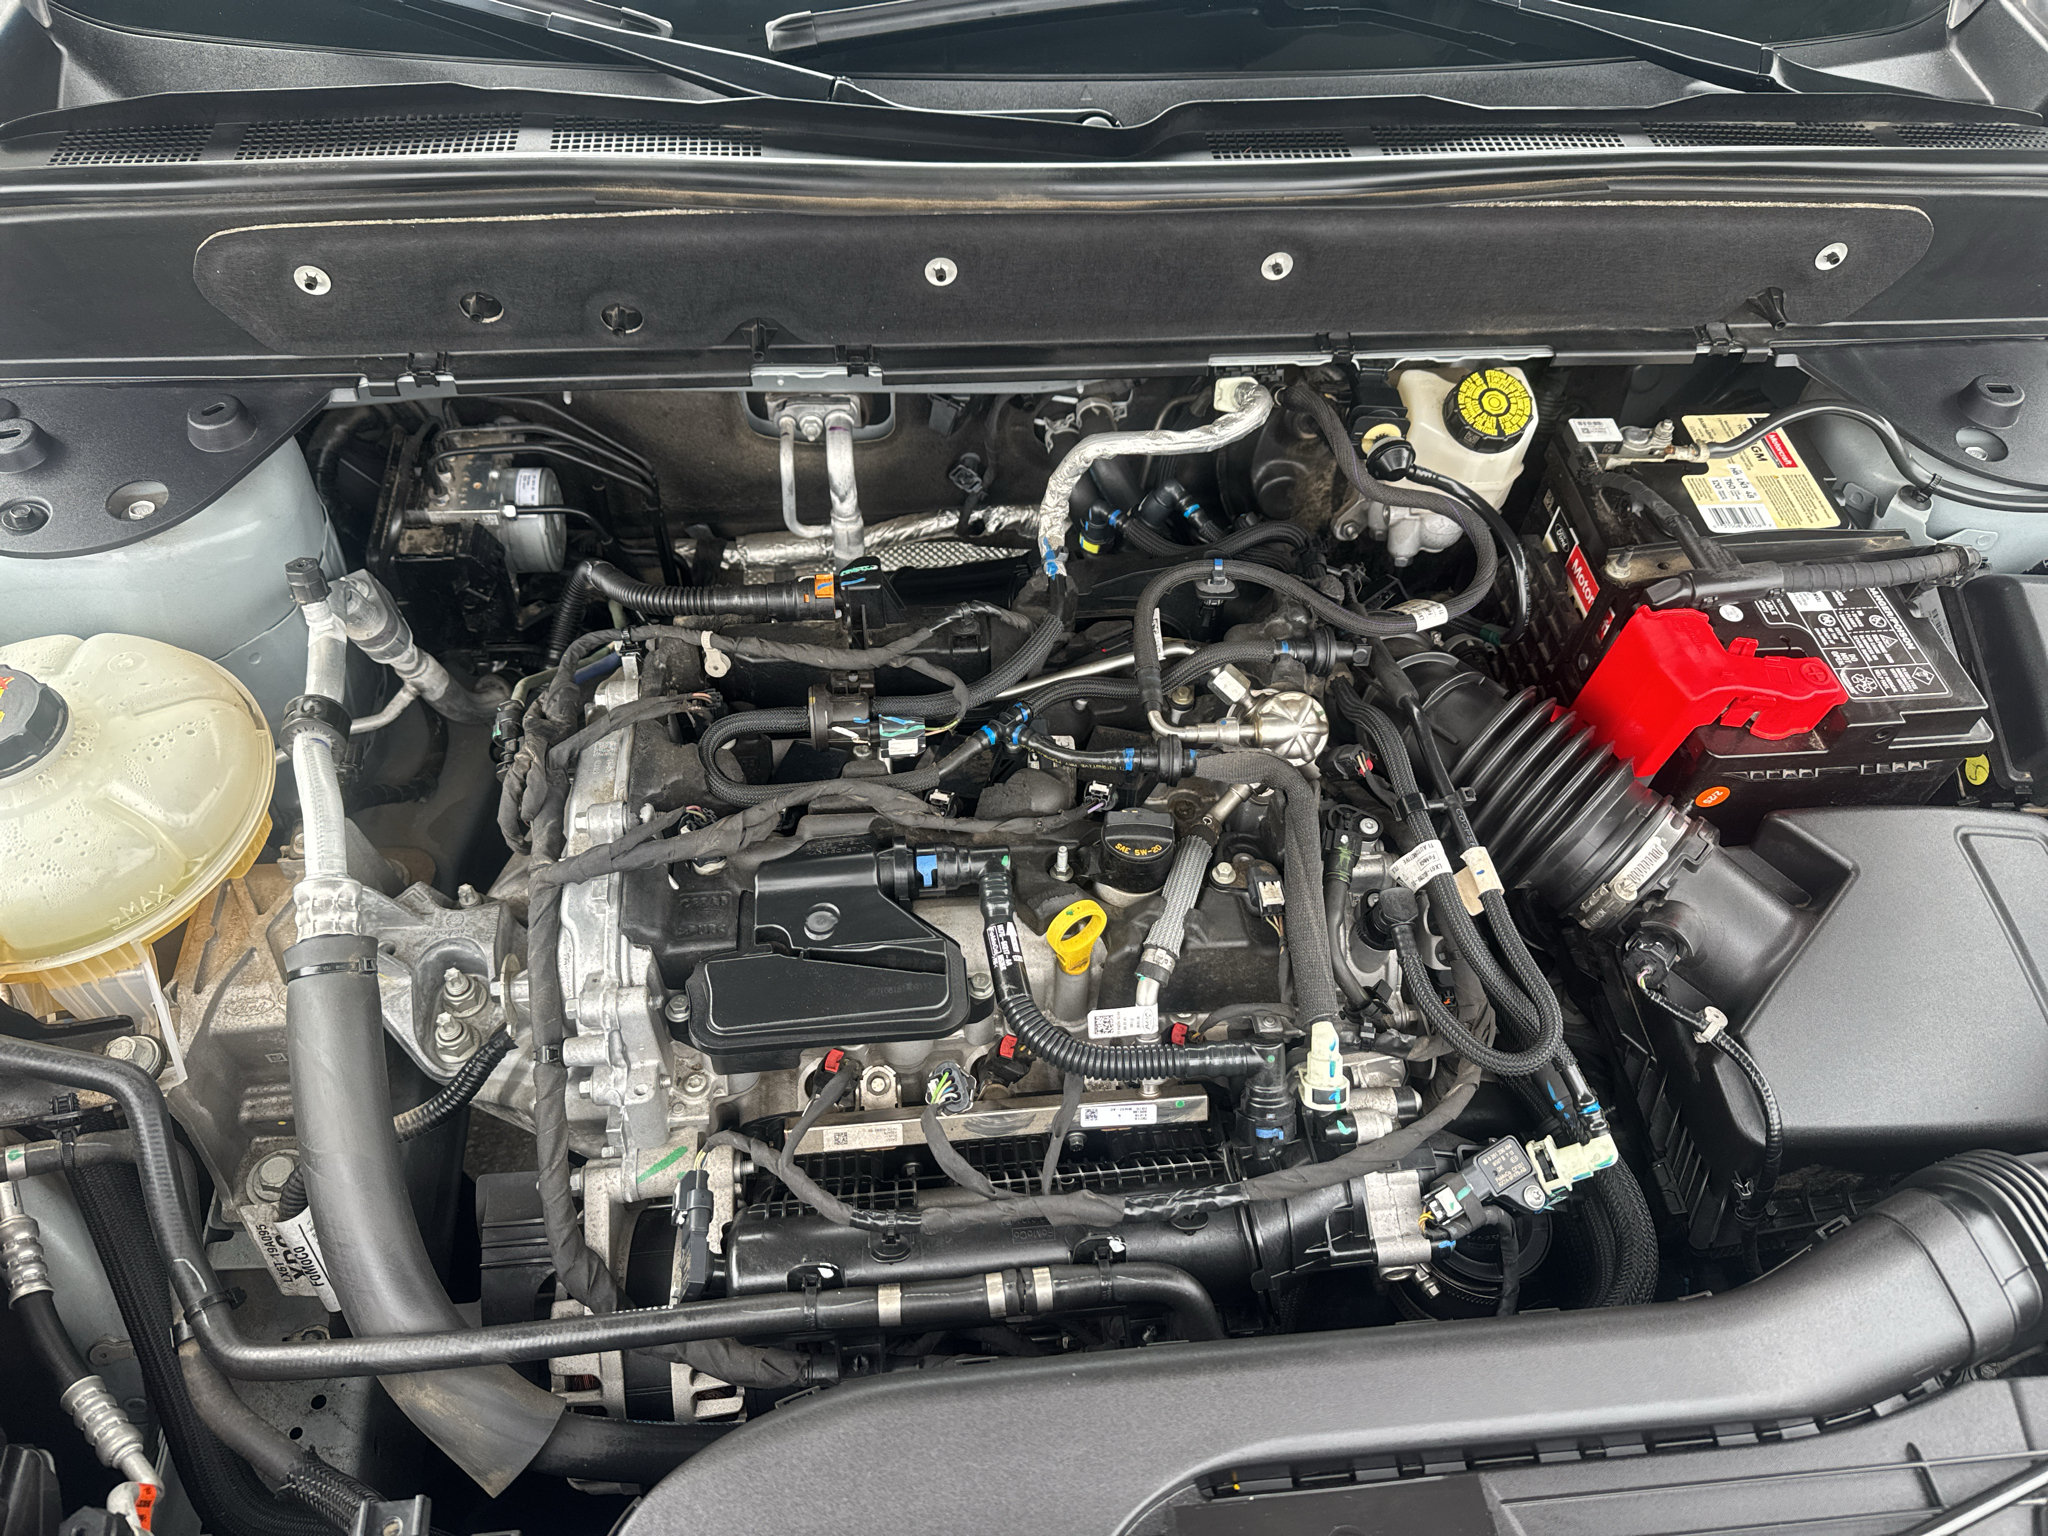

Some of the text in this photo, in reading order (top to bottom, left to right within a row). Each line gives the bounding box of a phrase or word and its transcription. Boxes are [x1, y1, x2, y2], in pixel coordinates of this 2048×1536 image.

[1767, 432, 1794, 467] Motorcraft
[1840, 653, 1853, 664] NOT
[1848, 654, 1859, 662] DO
[1702, 791, 1724, 804] 2/25
[1114, 842, 1163, 857] SAE 5W-20
[119, 884, 176, 920] MAX
[294, 1246, 325, 1287] FoMoCo
